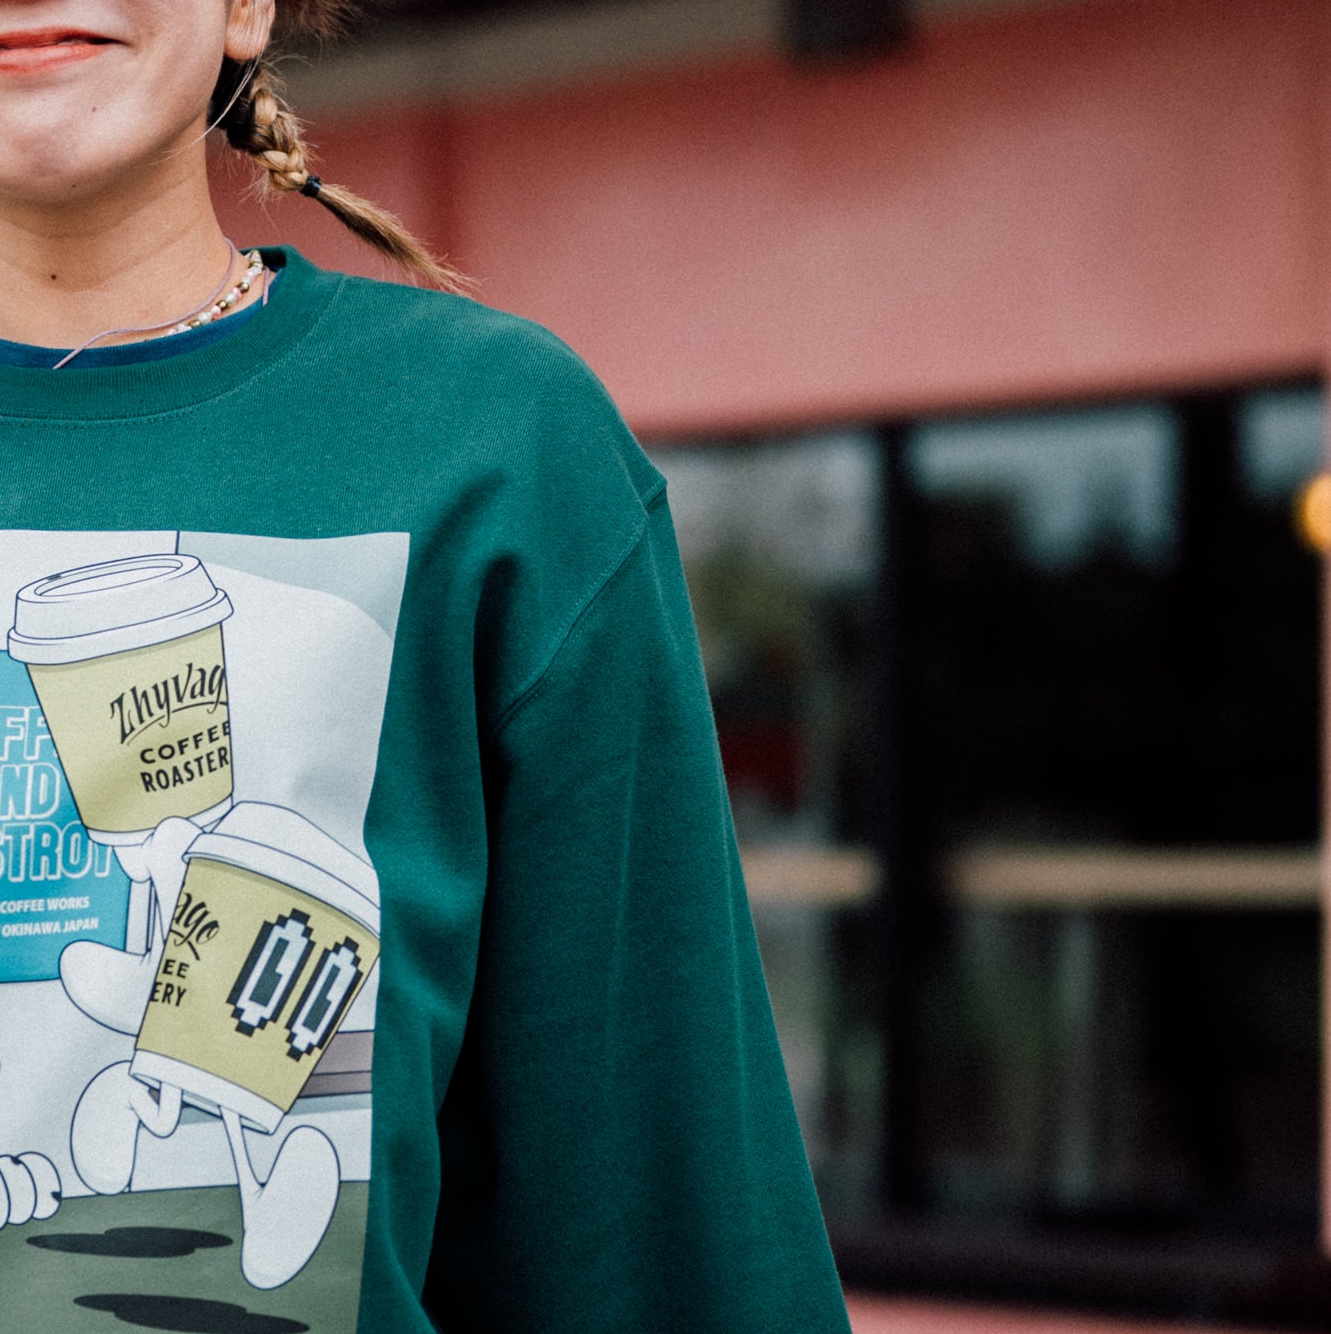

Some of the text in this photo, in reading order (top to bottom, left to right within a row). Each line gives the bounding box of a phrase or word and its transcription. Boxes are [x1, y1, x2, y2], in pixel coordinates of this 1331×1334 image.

[140, 746, 230, 793] ROASTER
[0, 898, 45, 915] COFFEE
[47, 895, 90, 910] WORKS
[1, 921, 61, 937] OKINAWA
[62, 917, 100, 933] JAPAN
